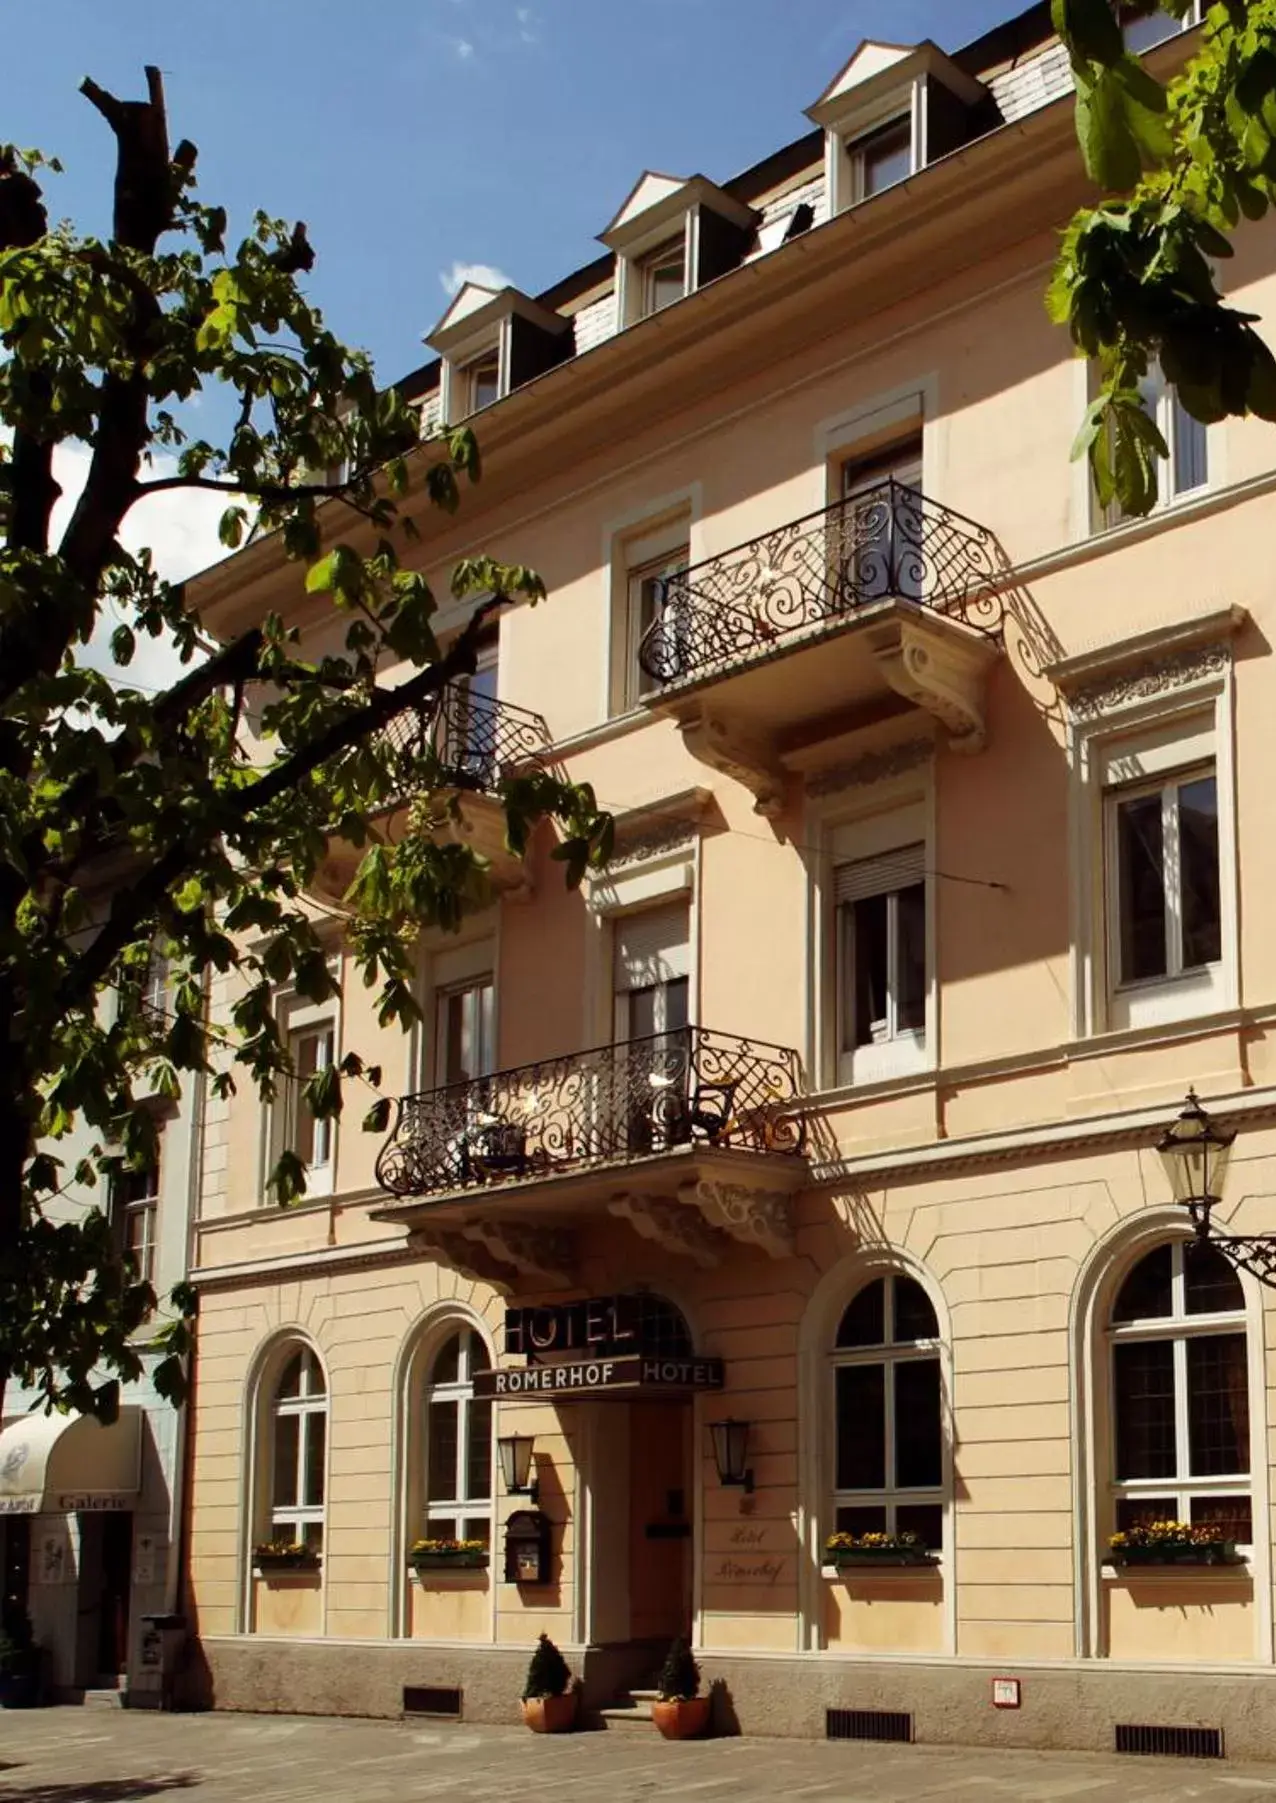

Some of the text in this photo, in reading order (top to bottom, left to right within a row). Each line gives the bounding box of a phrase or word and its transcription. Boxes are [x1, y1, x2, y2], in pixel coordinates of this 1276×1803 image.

[505, 1295, 634, 1352] HOTEL
[643, 1361, 721, 1384] HOTEL
[59, 1493, 126, 1509] Galerie
